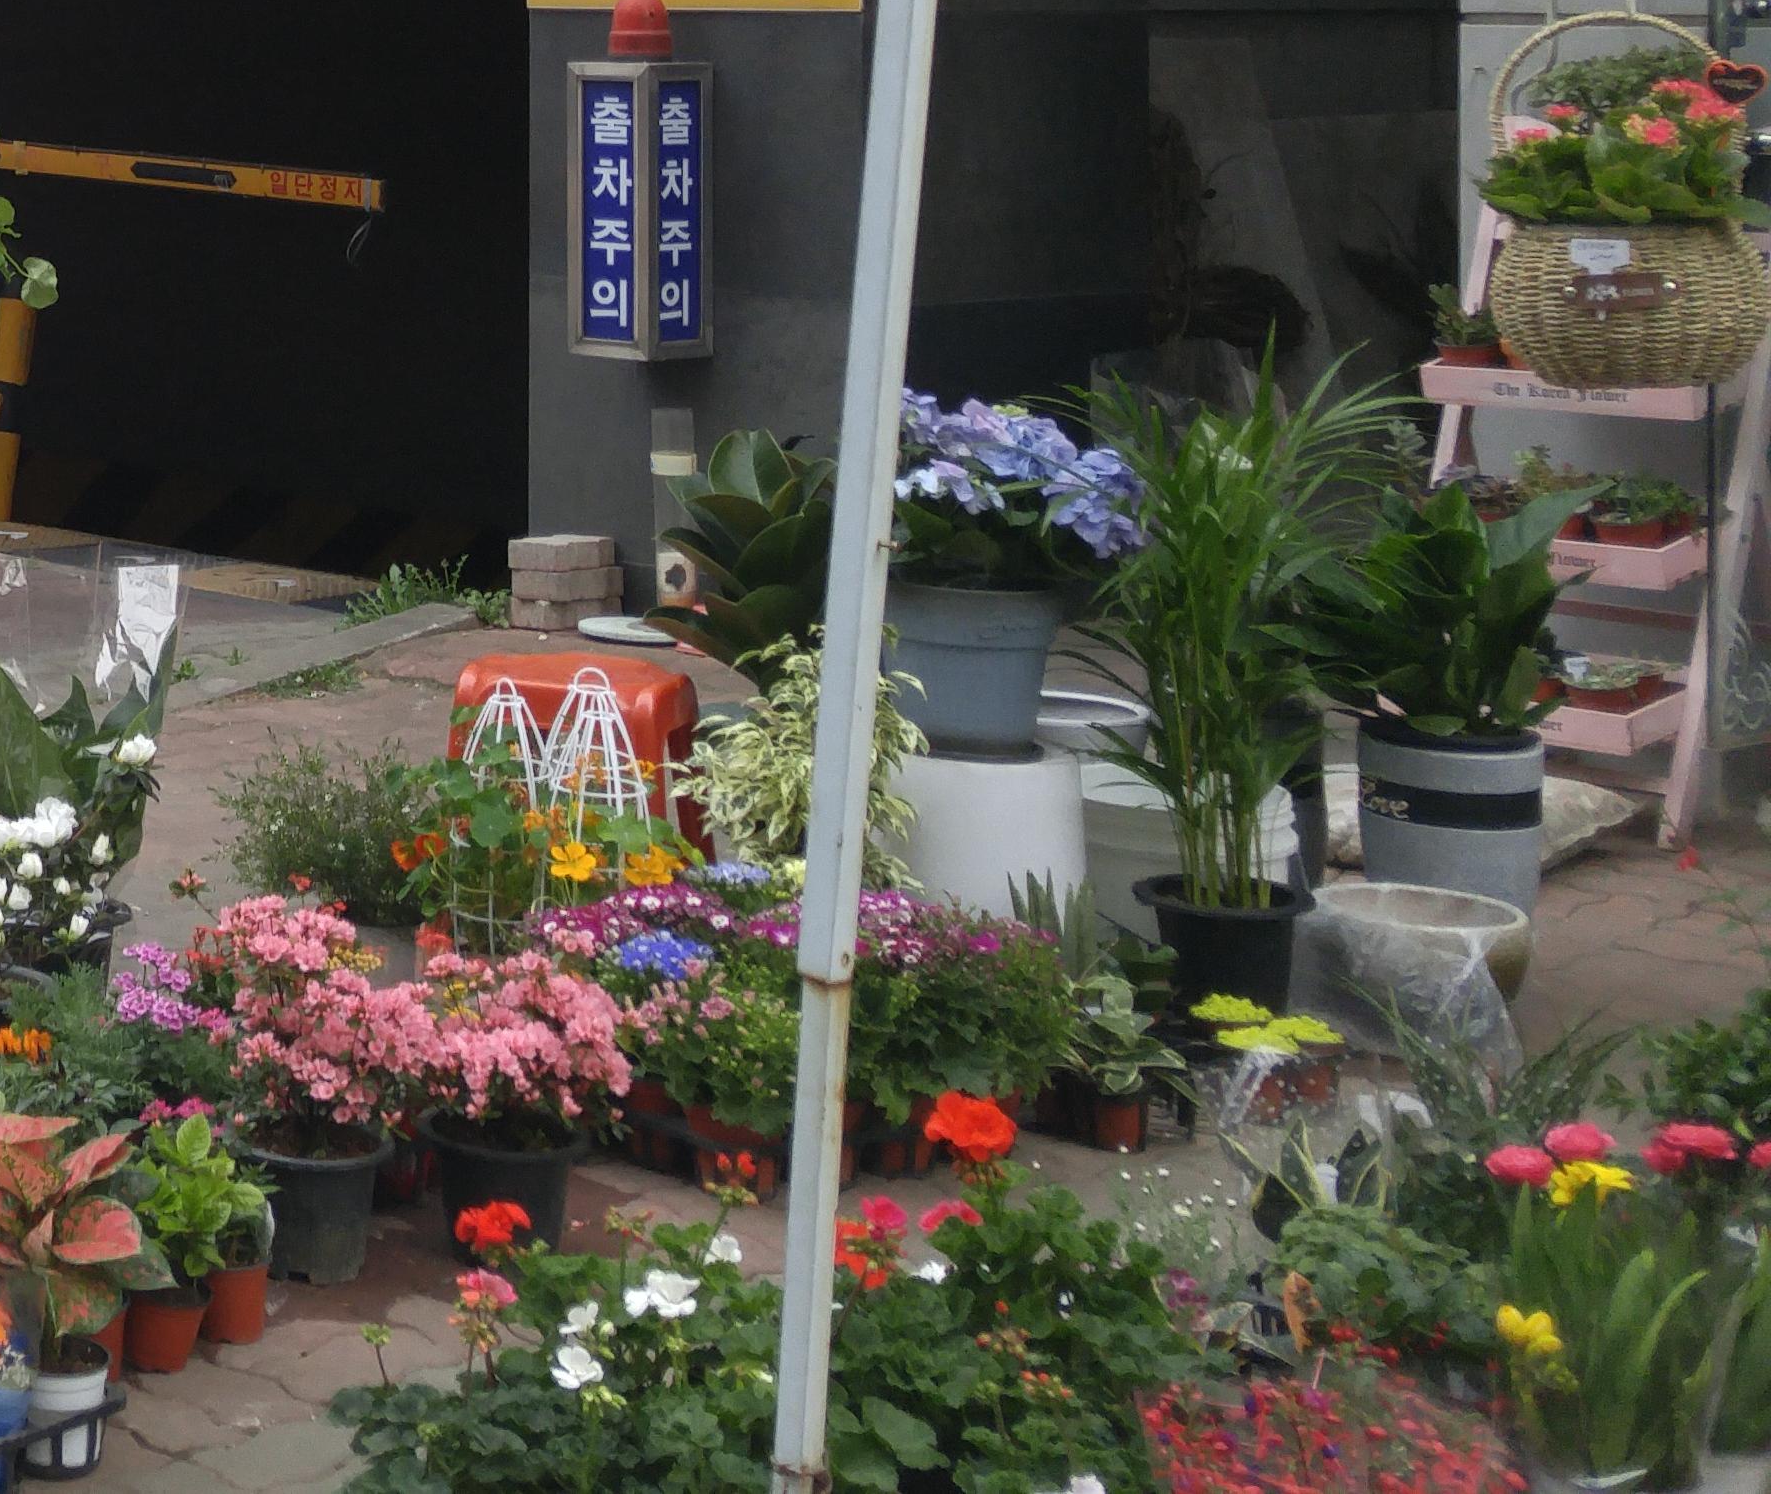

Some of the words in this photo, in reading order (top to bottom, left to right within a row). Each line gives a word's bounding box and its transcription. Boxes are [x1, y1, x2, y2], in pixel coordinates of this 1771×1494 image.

[267, 170, 361, 203] 일단정지
[587, 94, 635, 328] 출차주의
[658, 94, 692, 330] 출차주의
